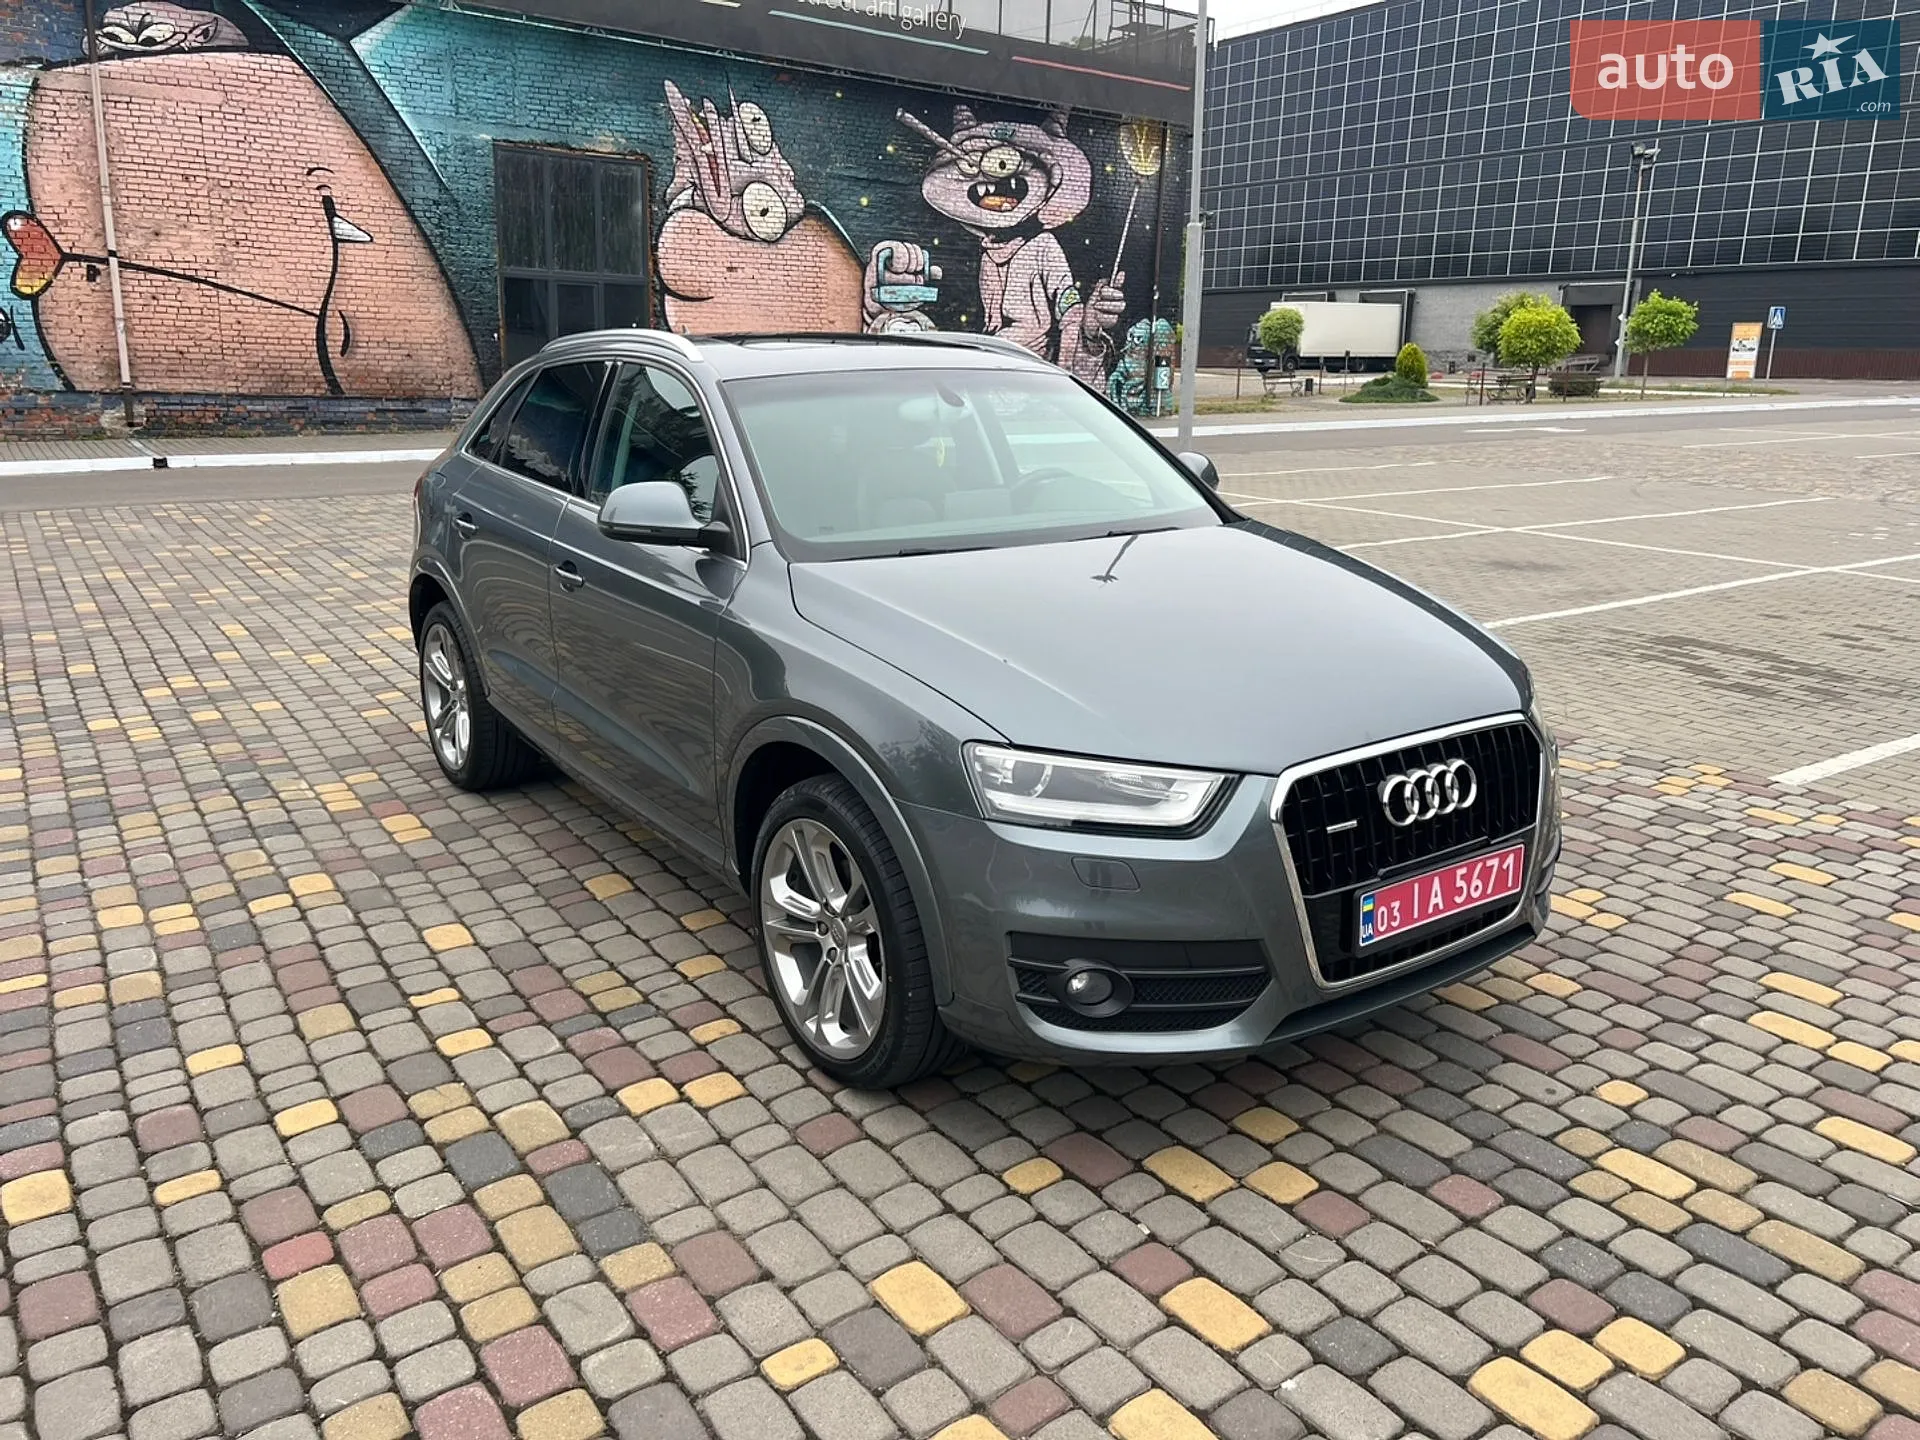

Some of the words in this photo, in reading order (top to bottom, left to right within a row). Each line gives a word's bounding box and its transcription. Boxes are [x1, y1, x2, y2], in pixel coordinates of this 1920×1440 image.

[865, 0, 897, 21] art
[901, 4, 967, 40] gallery
[1377, 900, 1401, 933] 03
[1453, 852, 1516, 904] 5671
